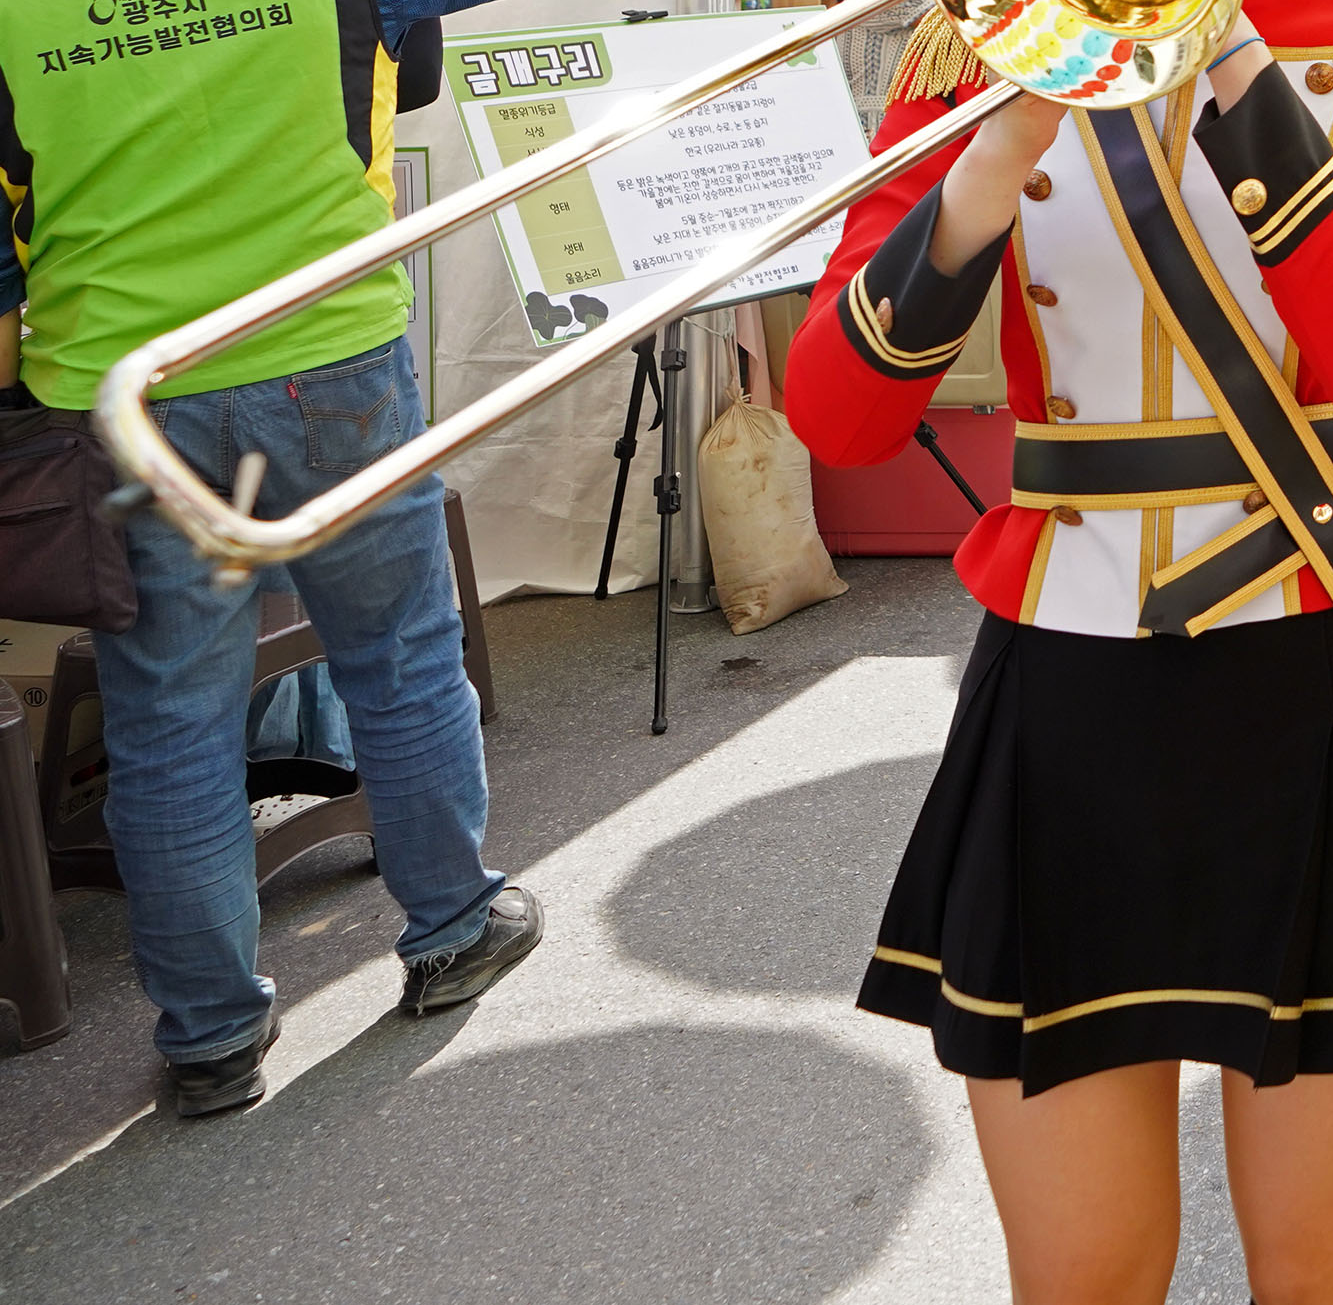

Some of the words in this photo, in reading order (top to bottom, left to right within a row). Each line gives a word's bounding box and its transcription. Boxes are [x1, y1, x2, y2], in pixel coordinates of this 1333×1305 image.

[37, 3, 294, 75] 지속가능발전협의회
[461, 41, 603, 96] 금개구리
[499, 103, 556, 120] 멸종위기등급
[712, 101, 750, 115] 절지동물과
[753, 97, 775, 108] 지렁이
[525, 127, 545, 138] 식성
[668, 128, 685, 139] 낮은
[753, 117, 769, 128] 습지
[685, 145, 702, 158] 한국
[703, 141, 739, 155] (우리나라
[740, 137, 766, 149] 고유종)
[617, 179, 634, 192] 등은
[636, 175, 654, 188] 밝은
[656, 170, 689, 184] 녹색이고
[691, 166, 716, 179] 양쪽에
[718, 162, 741, 174] 2개의
[758, 156, 781, 167] 뚜렷한
[812, 148, 835, 160] 있으며
[682, 181, 700, 192] 진한
[752, 169, 777, 181] 변하여
[808, 161, 823, 170] 자고
[675, 193, 701, 204] 기온이
[702, 186, 743, 201] 상승하면서
[744, 182, 761, 192] 다시
[762, 177, 791, 190] 녹색으로
[549, 201, 570, 215] 형태
[681, 214, 697, 225] 5월
[653, 232, 671, 245] 낮은
[673, 229, 691, 240] 지대
[564, 242, 584, 255] 생태
[632, 253, 682, 271] 울음주머니가
[565, 268, 601, 285] 울음소리
